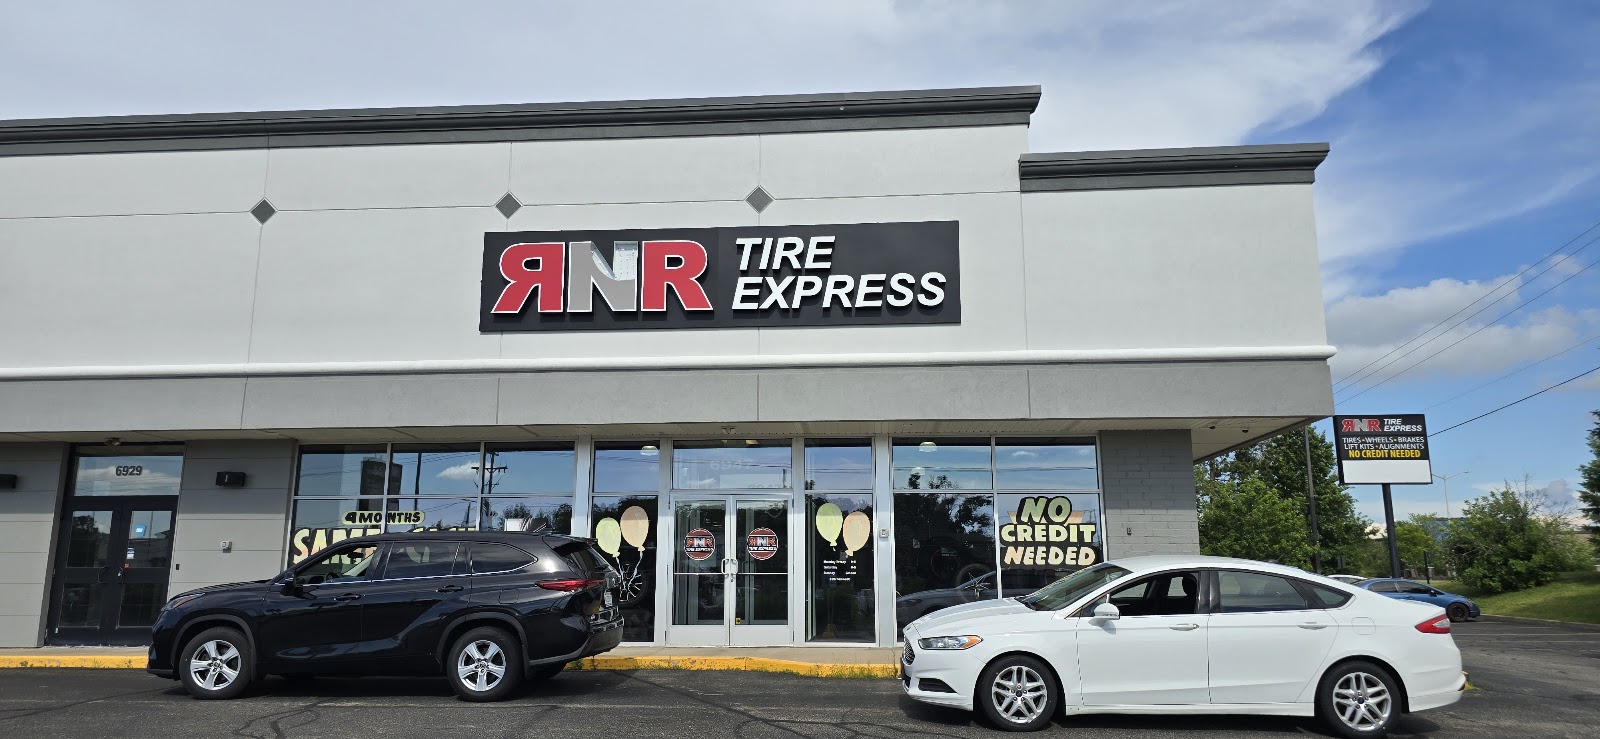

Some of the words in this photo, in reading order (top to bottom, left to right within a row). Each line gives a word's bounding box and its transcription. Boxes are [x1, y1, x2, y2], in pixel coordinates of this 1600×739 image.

[735, 235, 836, 271] TIRE
[491, 240, 714, 314] RNR
[731, 271, 947, 311] EXPRESS
[1342, 418, 1381, 432] RNR
[1349, 450, 1360, 458] NO
[1362, 450, 1388, 458] CREDIT
[1390, 450, 1421, 458] NEEDED
[115, 465, 143, 477] 6929
[344, 511, 357, 524] 4
[1019, 496, 1072, 524] NO
[1000, 523, 1097, 543] CREDIT
[1003, 546, 1097, 567] NEEDED
